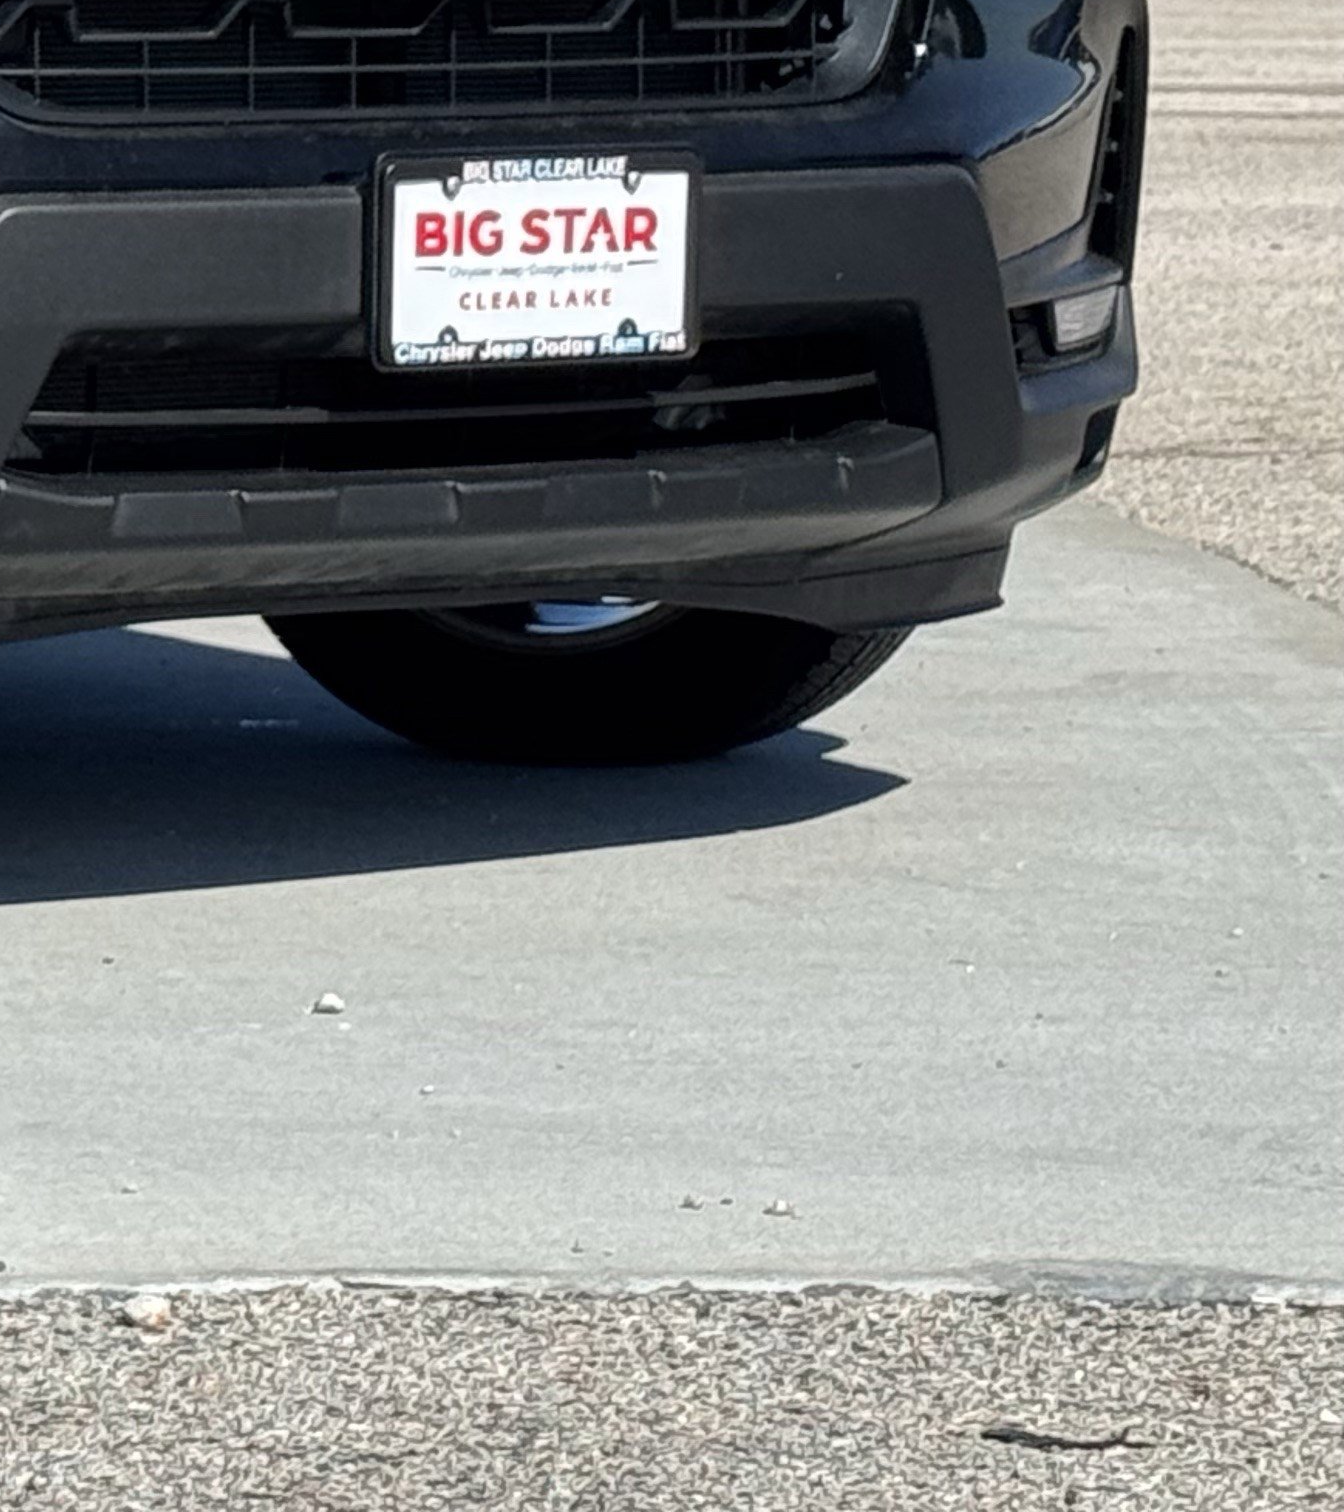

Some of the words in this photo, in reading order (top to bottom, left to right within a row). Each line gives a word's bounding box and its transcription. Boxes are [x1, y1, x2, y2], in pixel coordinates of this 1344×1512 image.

[414, 209, 504, 258] BIG
[519, 206, 658, 255] STAR
[459, 290, 537, 311] CLEAR
[549, 287, 613, 309] LAKE
